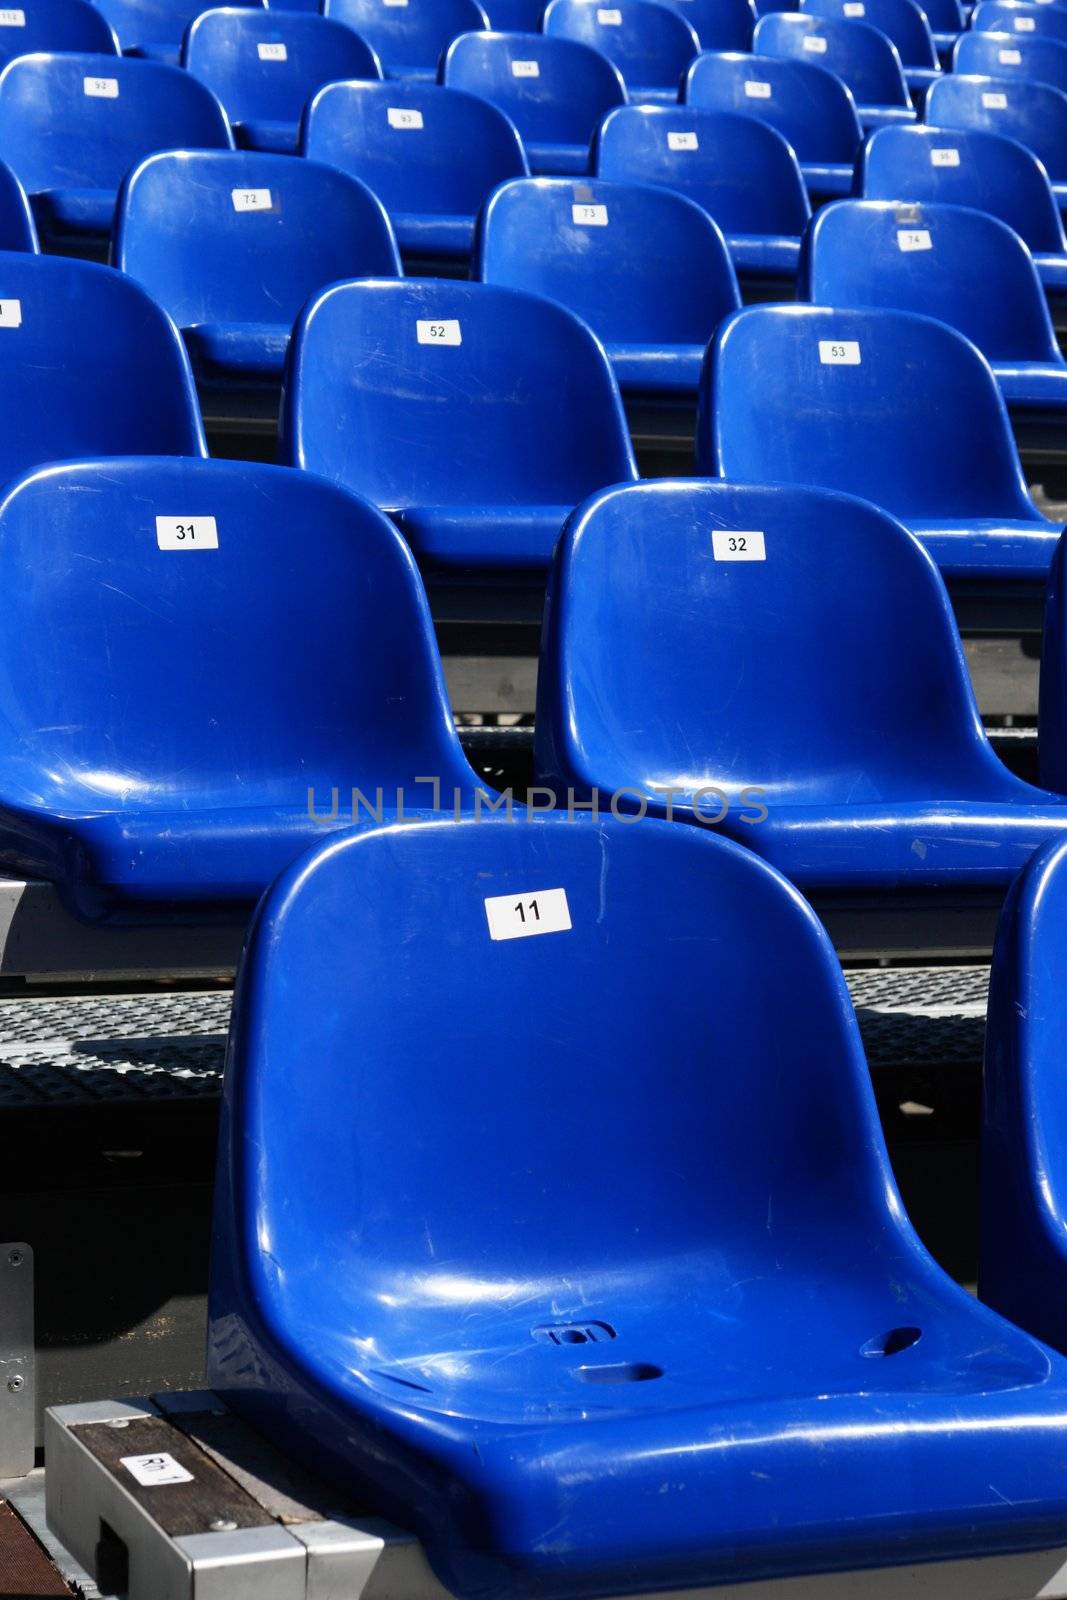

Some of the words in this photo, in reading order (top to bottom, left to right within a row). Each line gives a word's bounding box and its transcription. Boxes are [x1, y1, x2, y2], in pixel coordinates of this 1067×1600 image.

[95, 81, 107, 90] 92
[400, 114, 412, 122] 93
[243, 194, 256, 204] 72
[583, 209, 596, 218] 73
[907, 235, 920, 243] 74
[430, 326, 445, 337] 52
[832, 346, 845, 357] 53
[176, 525, 195, 540] 31
[728, 538, 747, 551] 32
[514, 900, 540, 923] 11
